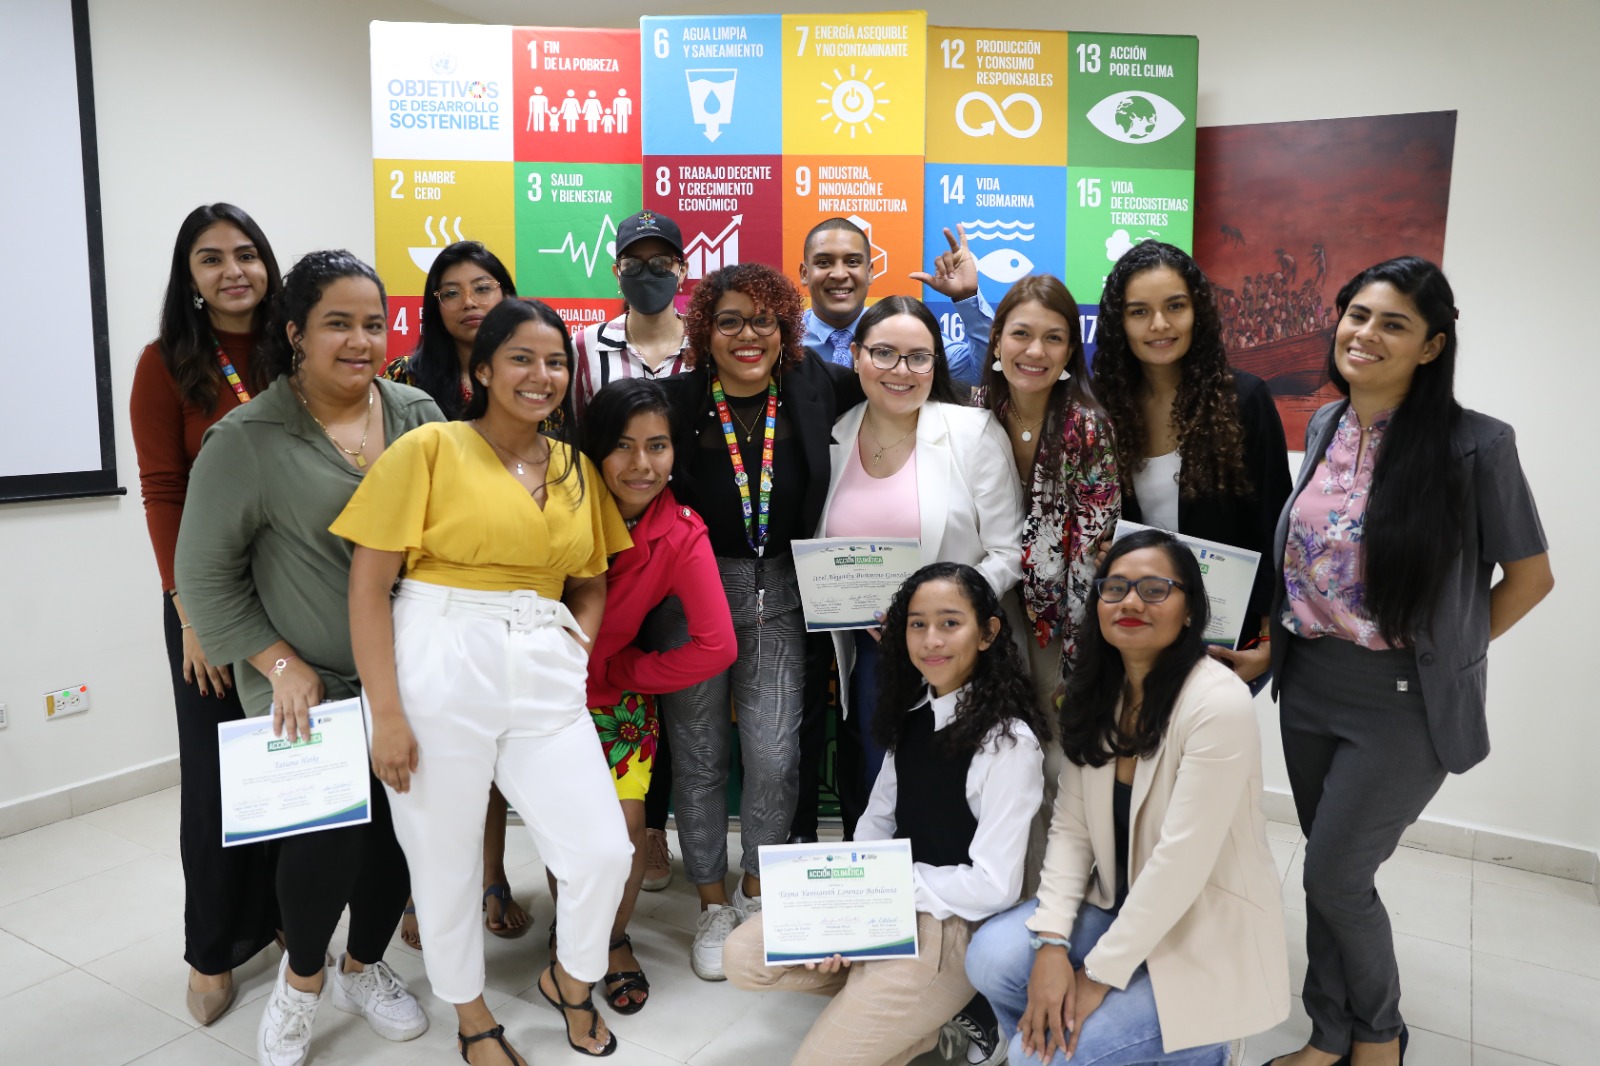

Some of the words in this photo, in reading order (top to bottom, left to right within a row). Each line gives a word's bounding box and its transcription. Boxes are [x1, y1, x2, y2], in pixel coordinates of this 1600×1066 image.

[683, 27, 711, 41] AGUA
[713, 27, 747, 41] LIMPIA
[815, 24, 855, 40] ENERGÍA
[857, 26, 908, 40] ASEQUIBLE
[544, 41, 560, 55] FIN
[654, 28, 669, 58] 6
[795, 26, 809, 57] 7
[976, 39, 1041, 55] PRODUCCIÓN
[527, 40, 537, 69] 1
[683, 45, 690, 58] Y
[691, 44, 764, 58] SANEAMIENTO
[815, 44, 822, 57] Y
[823, 44, 836, 57] NO
[837, 43, 909, 57] CONTAMINANTE
[940, 39, 965, 69] 12
[1110, 45, 1147, 61] ACCIÓN
[544, 57, 558, 71] DE
[559, 57, 572, 71] LA
[573, 58, 619, 72] POBREZA
[977, 56, 984, 69] Y
[985, 56, 1034, 70] CONSUMO
[1076, 43, 1101, 73] 13
[1110, 63, 1130, 77] POR
[1131, 64, 1142, 77] EL
[1144, 64, 1174, 78] CLIMA
[976, 72, 1053, 87] RESPONSABLES
[388, 79, 499, 98] OBJETIVOS
[389, 100, 408, 111] DE
[410, 100, 499, 113] DESARROLLO
[390, 113, 499, 130] SOSTENIBLE
[414, 171, 456, 184] HAMBRE
[551, 173, 583, 187] SALUD
[656, 166, 671, 196] 8
[679, 167, 726, 180] TRABAJO
[727, 167, 772, 180] DECENTE
[795, 166, 811, 196] 9
[818, 166, 872, 181] INDUSTRIA,
[390, 170, 405, 199] 2
[528, 173, 542, 202] 3
[679, 182, 685, 196] Y
[687, 182, 753, 196] CRECIMIENTO
[818, 180, 876, 196] INNOVACIÓN
[877, 182, 883, 196] E
[940, 174, 965, 204] 14
[976, 177, 1001, 191] VIDA
[1111, 181, 1134, 194] VIDA
[414, 187, 441, 200] CERO
[551, 190, 558, 203] Y
[559, 189, 613, 203] BIENESTAR
[1076, 178, 1101, 207] 15
[679, 196, 738, 211] ECONÓMICO
[818, 199, 907, 212] INFRAESTRUCTURA
[976, 194, 1035, 208] SUBMARINA
[1111, 197, 1124, 210] DE
[1125, 197, 1188, 212] ECOSISTEMAS
[1110, 212, 1168, 226] TERRESTRES
[393, 306, 409, 335] 4
[940, 312, 965, 342] 16
[1079, 315, 1098, 344] 17
[809, 866, 830, 878] ACCIÓN
[833, 866, 864, 877] CLIMÁTICA
